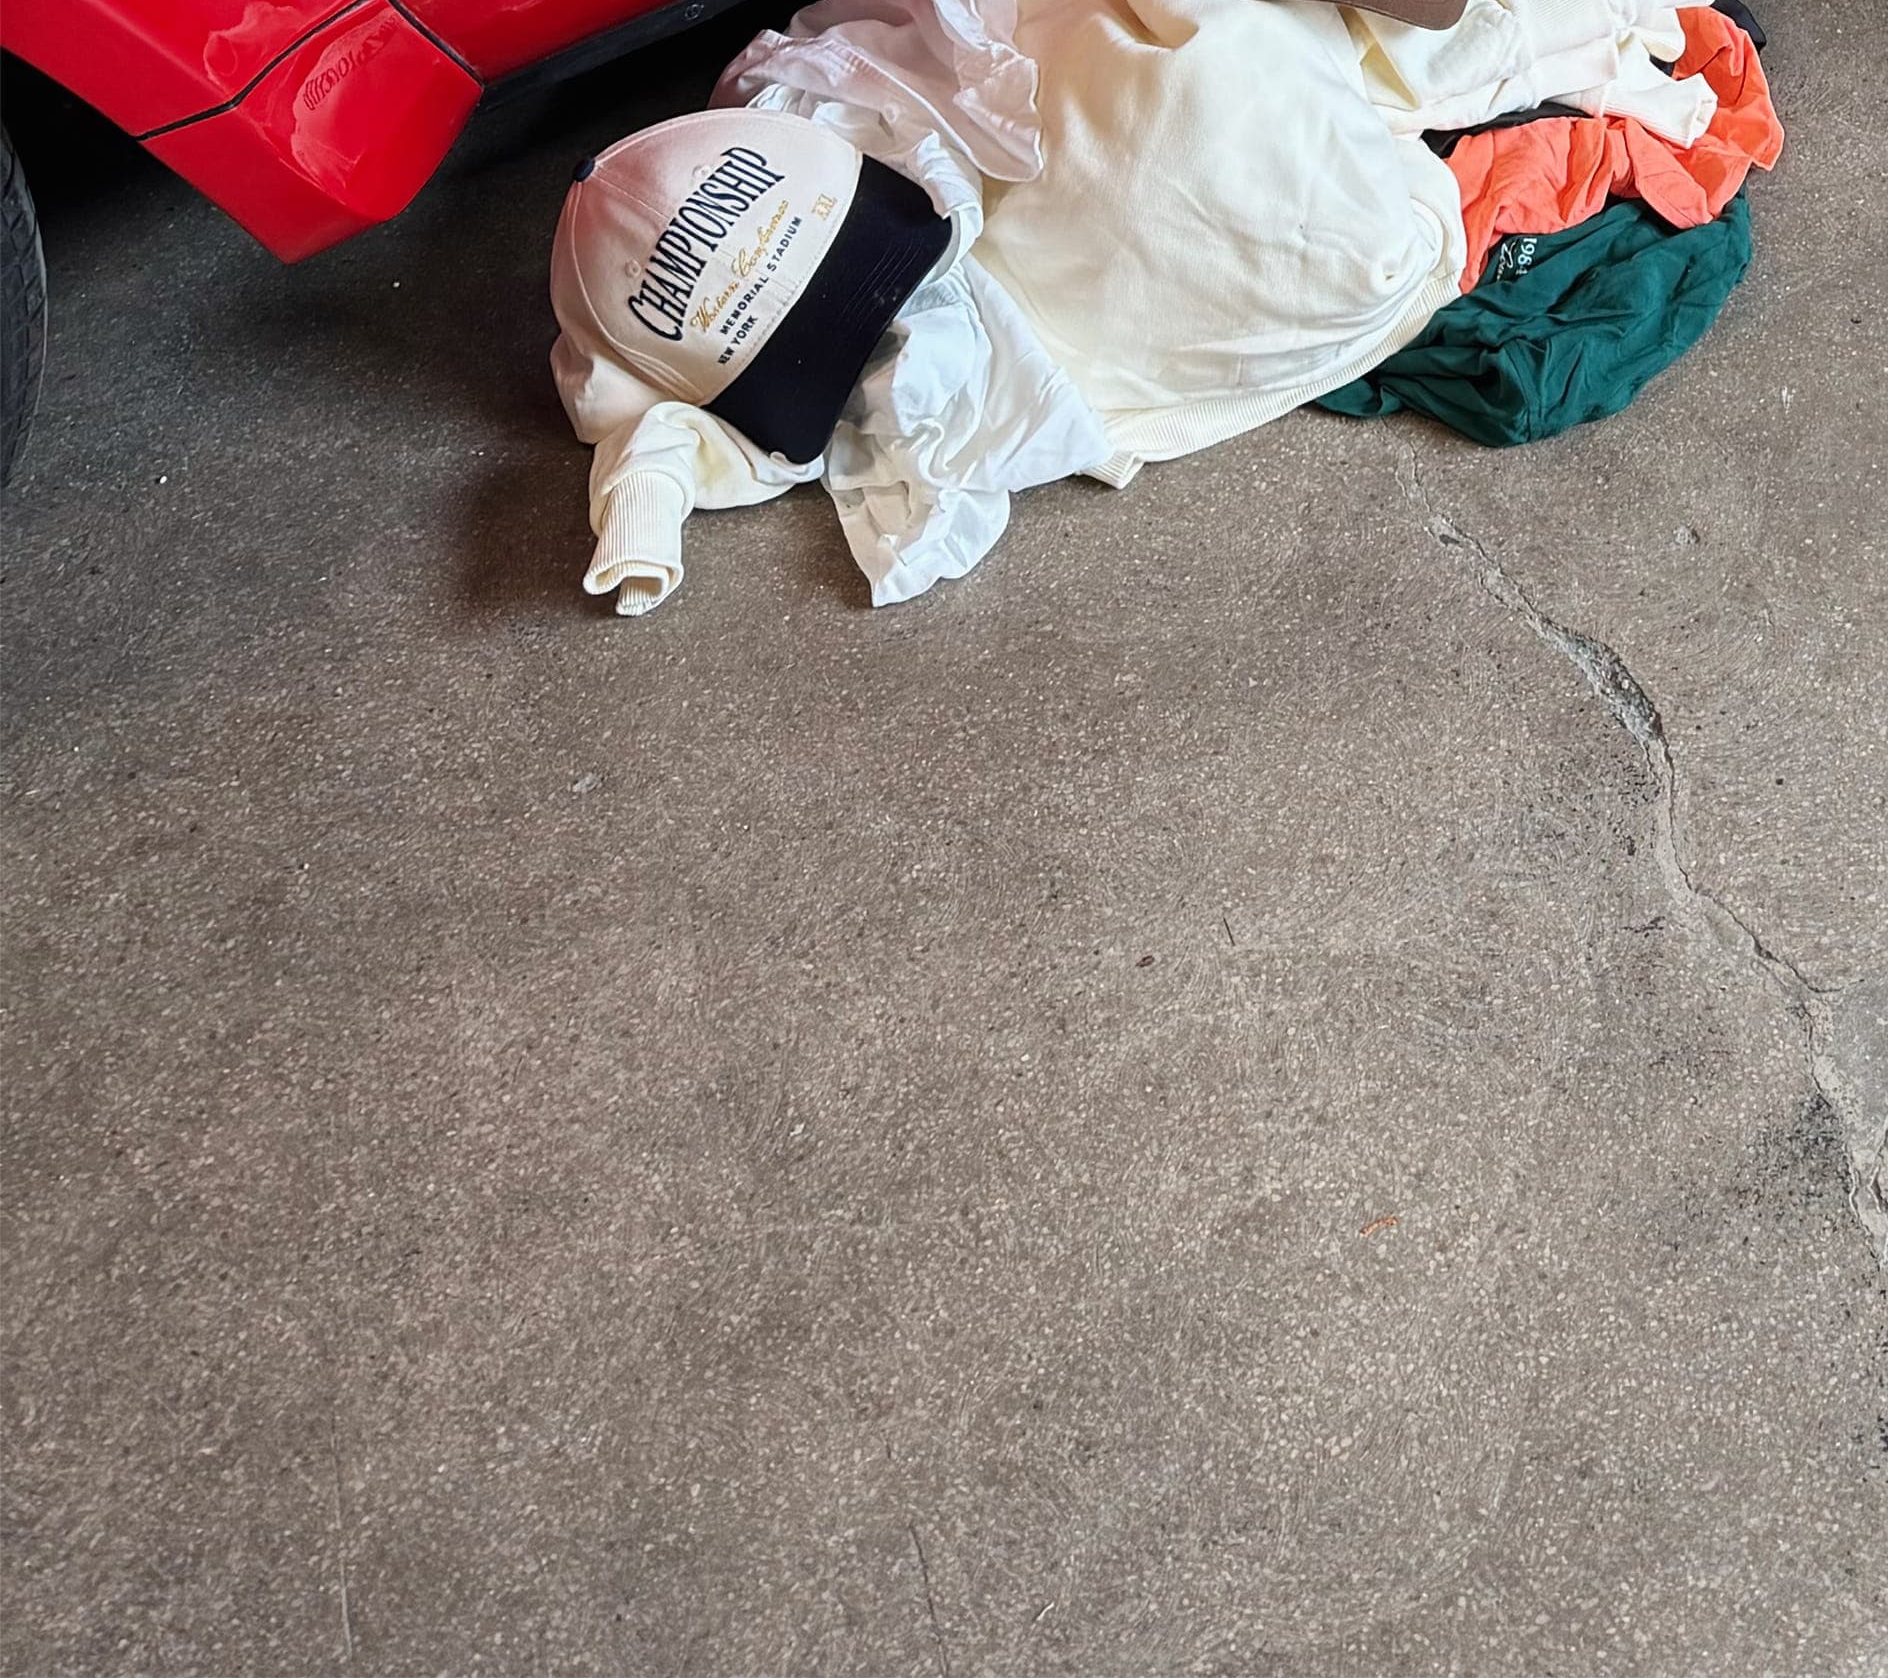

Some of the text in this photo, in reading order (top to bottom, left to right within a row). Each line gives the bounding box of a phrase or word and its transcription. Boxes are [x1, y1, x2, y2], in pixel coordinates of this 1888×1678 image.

[627, 146, 785, 342] CHAMPIONSHIP
[719, 216, 802, 337] MEMORIAL STADIUM
[717, 315, 759, 366] NEW YORK
